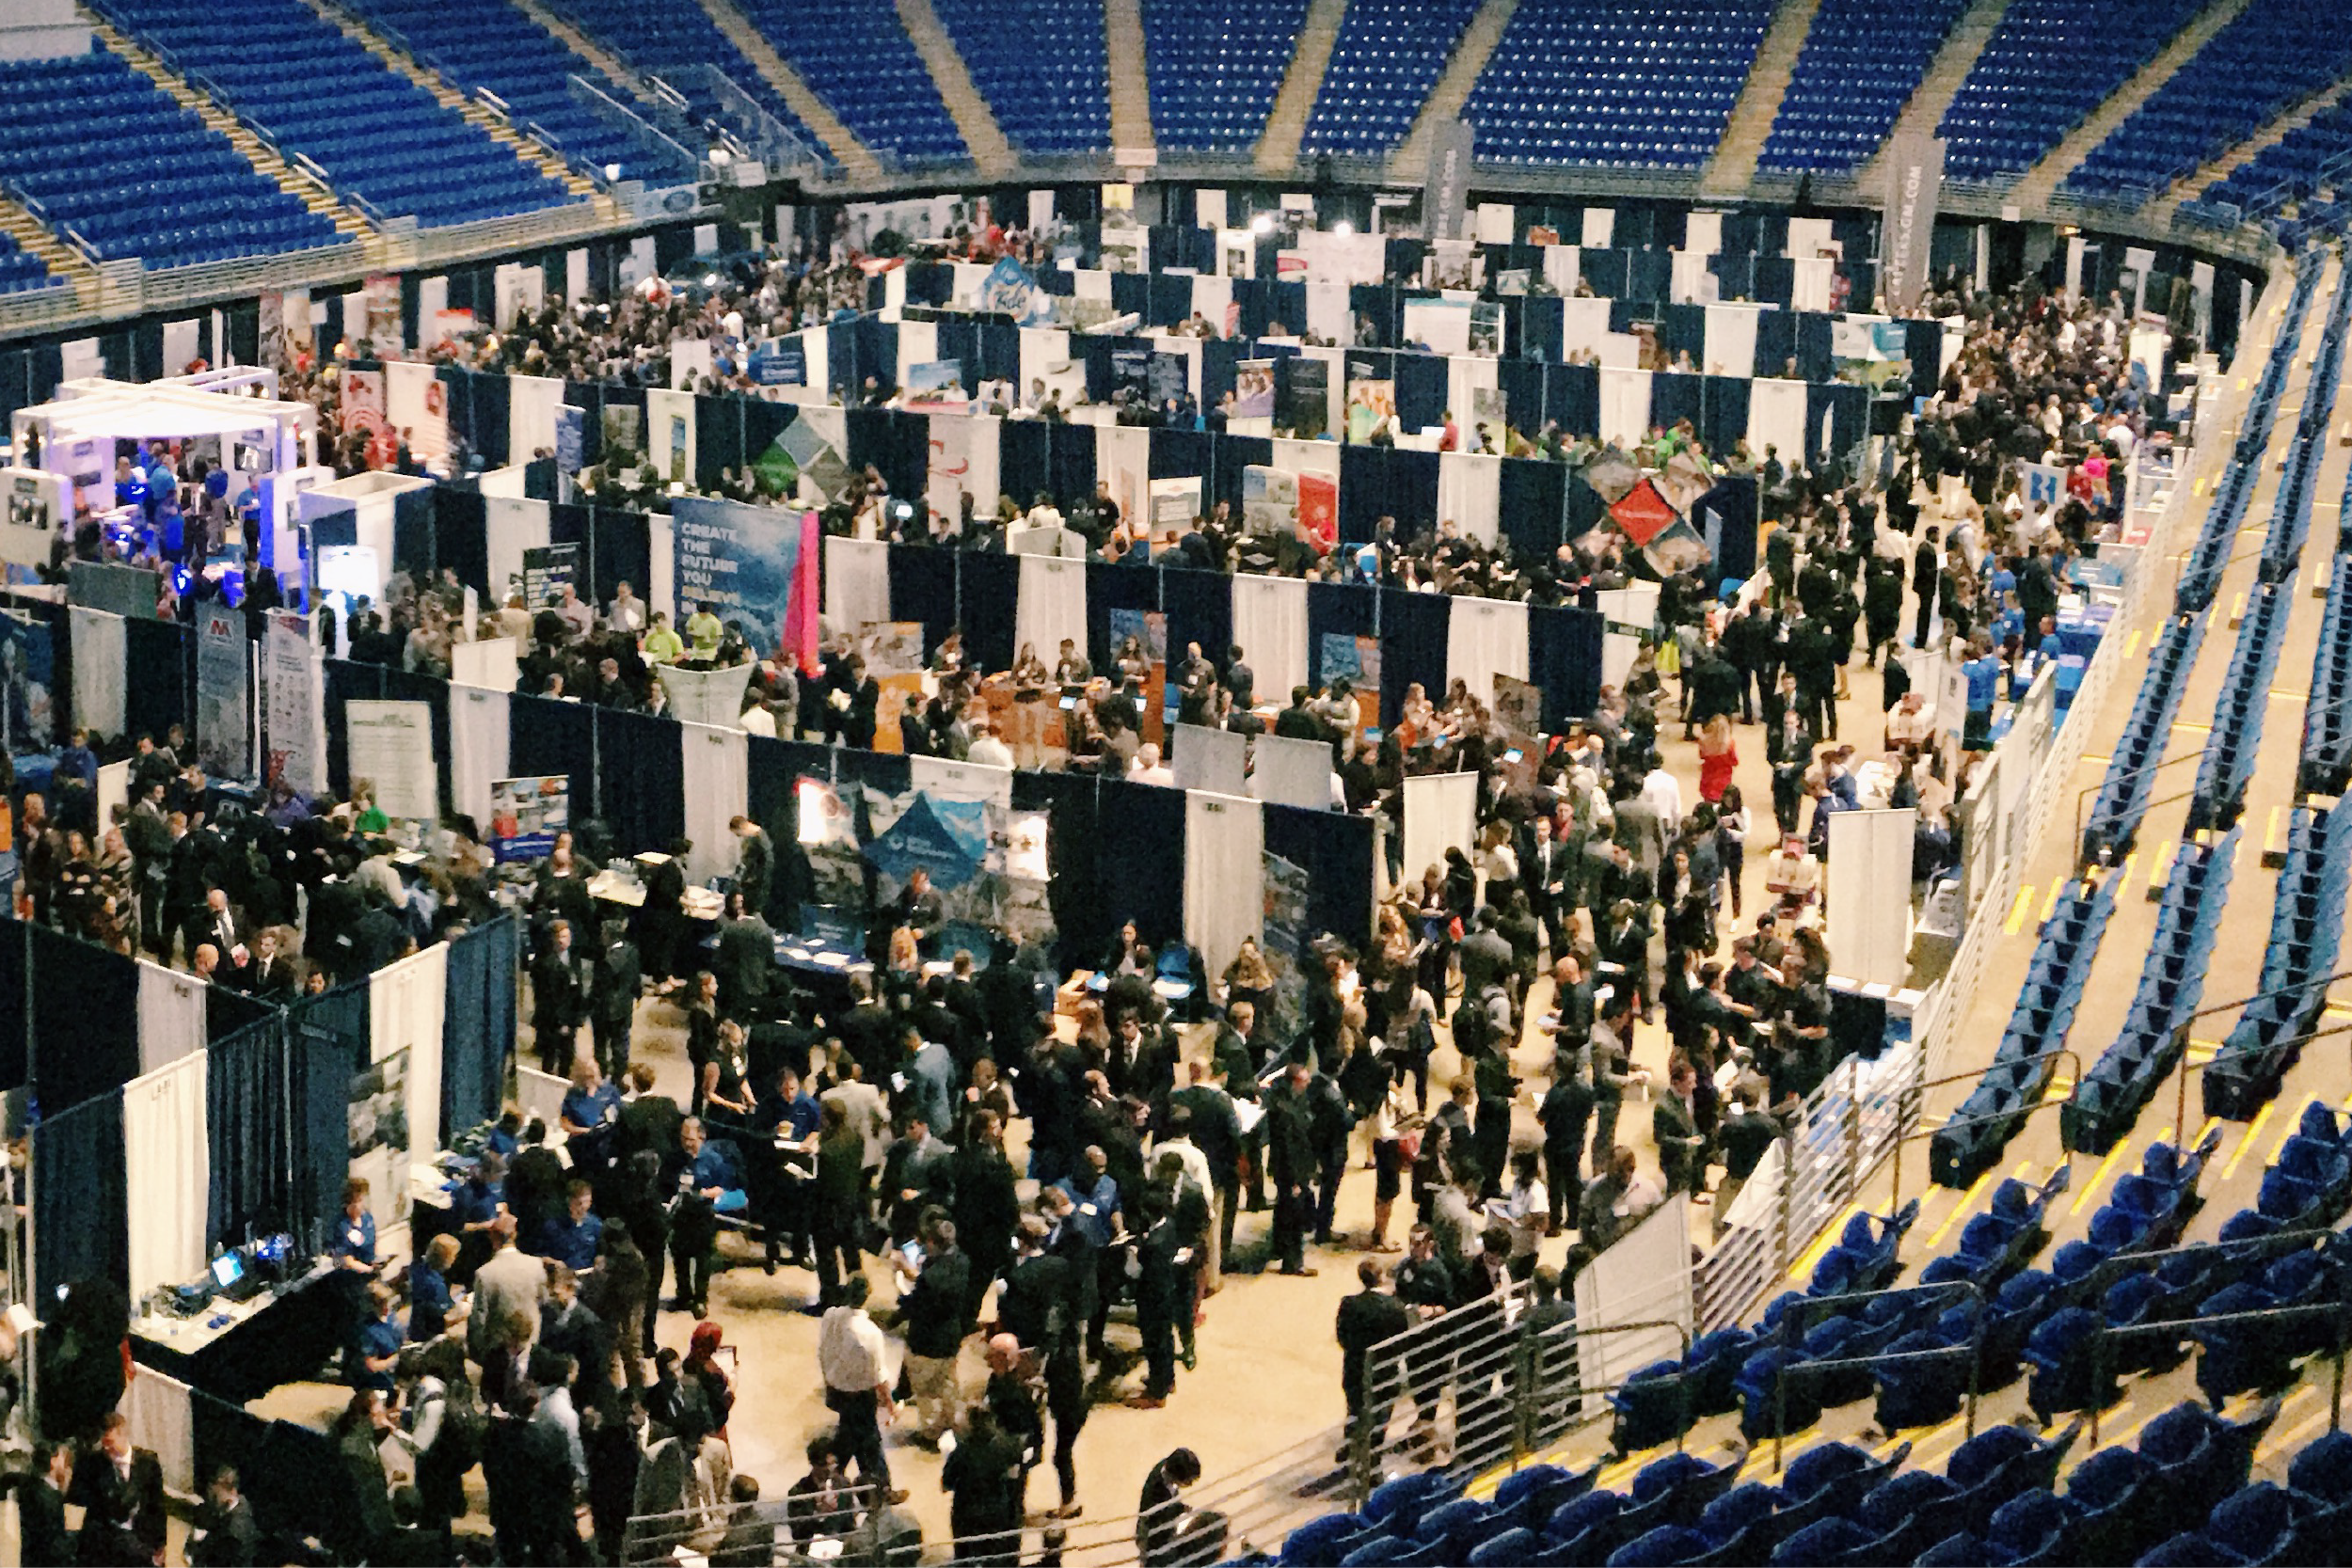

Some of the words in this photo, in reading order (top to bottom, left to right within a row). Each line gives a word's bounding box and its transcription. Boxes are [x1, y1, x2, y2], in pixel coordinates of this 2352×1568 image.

[681, 522, 738, 542] CREATE
[681, 538, 710, 554] THE
[681, 555, 739, 574] FUTURE
[682, 570, 712, 585] YOU
